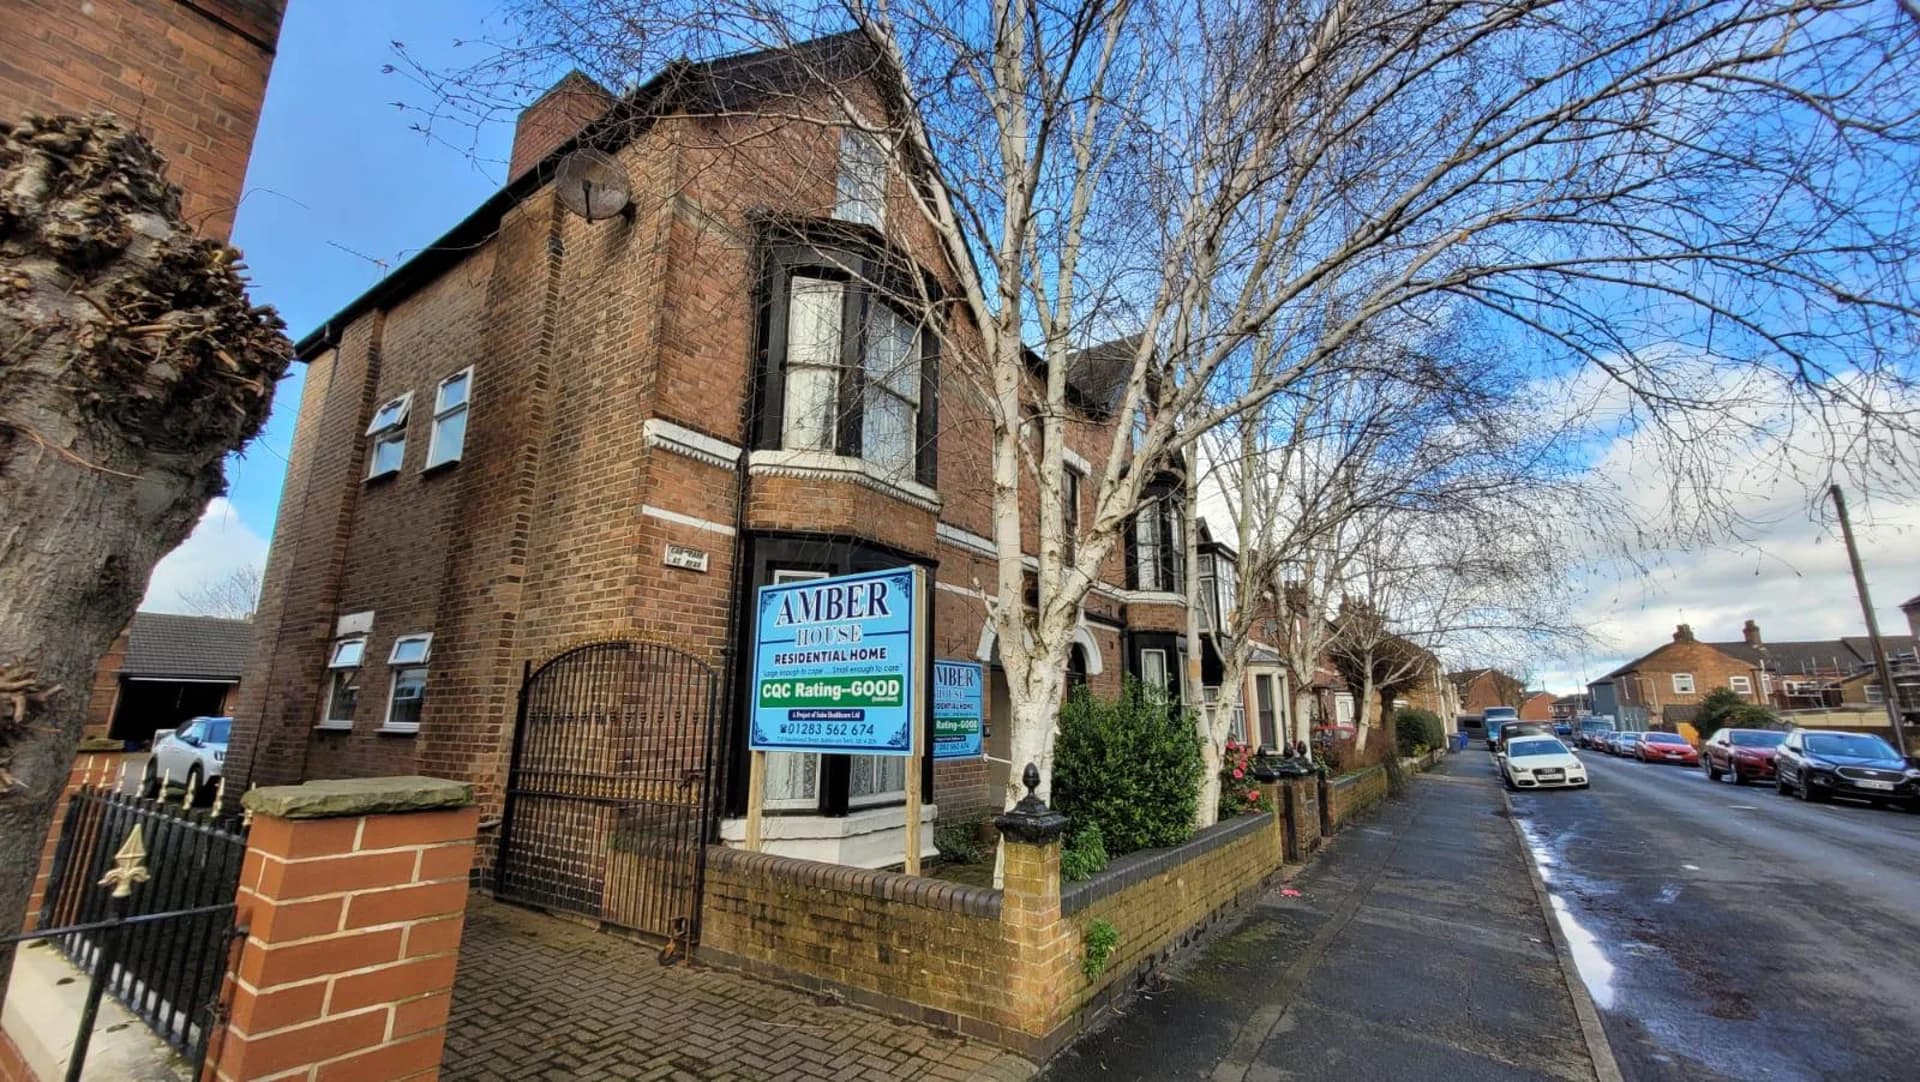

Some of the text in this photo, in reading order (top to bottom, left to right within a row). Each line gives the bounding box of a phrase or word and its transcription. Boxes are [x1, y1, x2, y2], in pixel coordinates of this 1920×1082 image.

[776, 582, 890, 626] AMBER
[797, 625, 862, 646] HOUSE
[774, 648, 887, 665] RESIDENTIAL HOME
[936, 666, 973, 686] MBER
[762, 683, 791, 699] CQC
[787, 723, 875, 736] 01283 562 674
